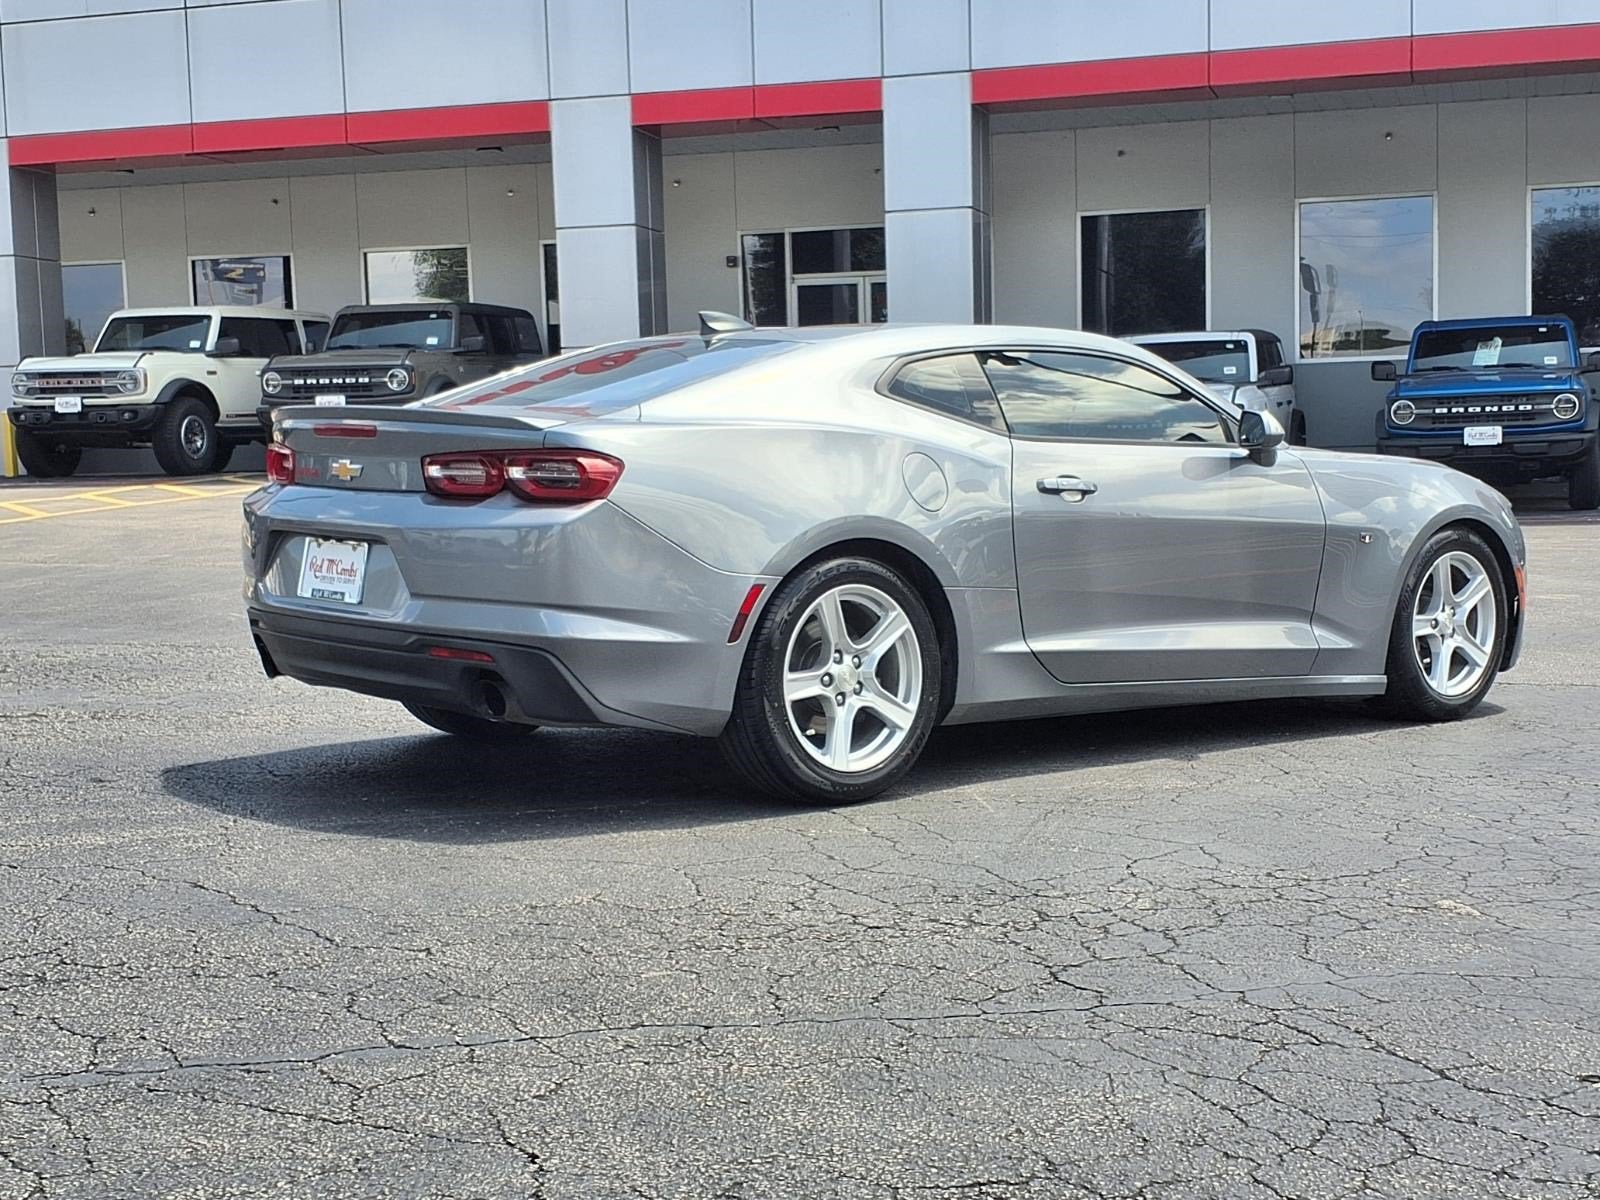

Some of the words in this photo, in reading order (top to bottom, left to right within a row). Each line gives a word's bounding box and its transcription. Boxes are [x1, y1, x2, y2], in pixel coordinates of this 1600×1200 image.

[293, 377, 370, 385] BRONCO
[1434, 404, 1533, 414] BRONCO
[309, 556, 325, 579] Red
